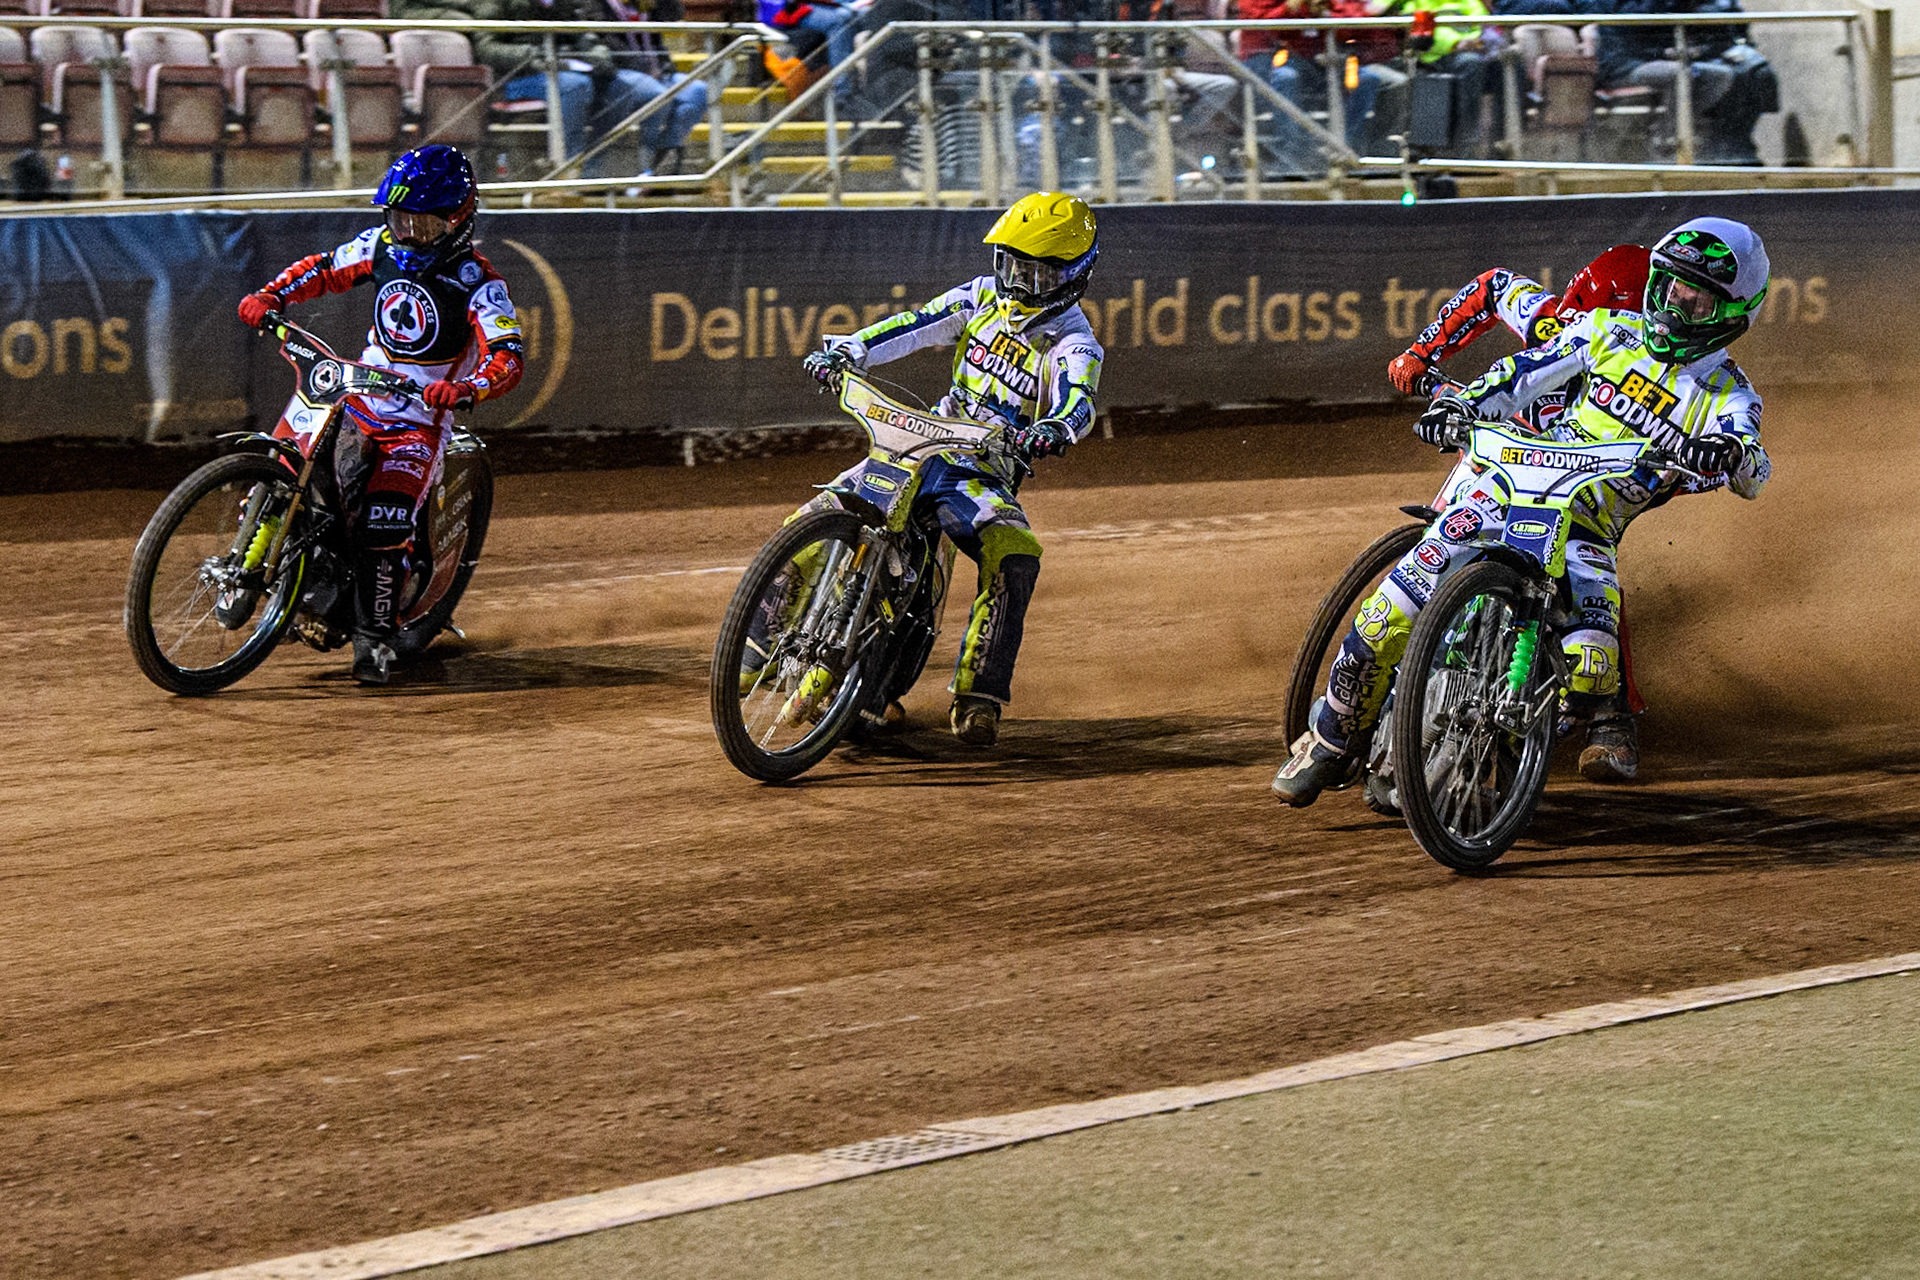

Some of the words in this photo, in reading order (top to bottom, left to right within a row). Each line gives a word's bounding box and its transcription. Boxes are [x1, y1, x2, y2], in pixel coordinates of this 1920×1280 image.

[421, 299, 435, 324] ACES
[1079, 277, 1190, 347] orld
[1208, 275, 1362, 344] class
[1620, 373, 1676, 416] BET
[1501, 448, 1599, 471] BETGOODWIN
[369, 506, 408, 521] DVR
[1418, 545, 1444, 566] STS
